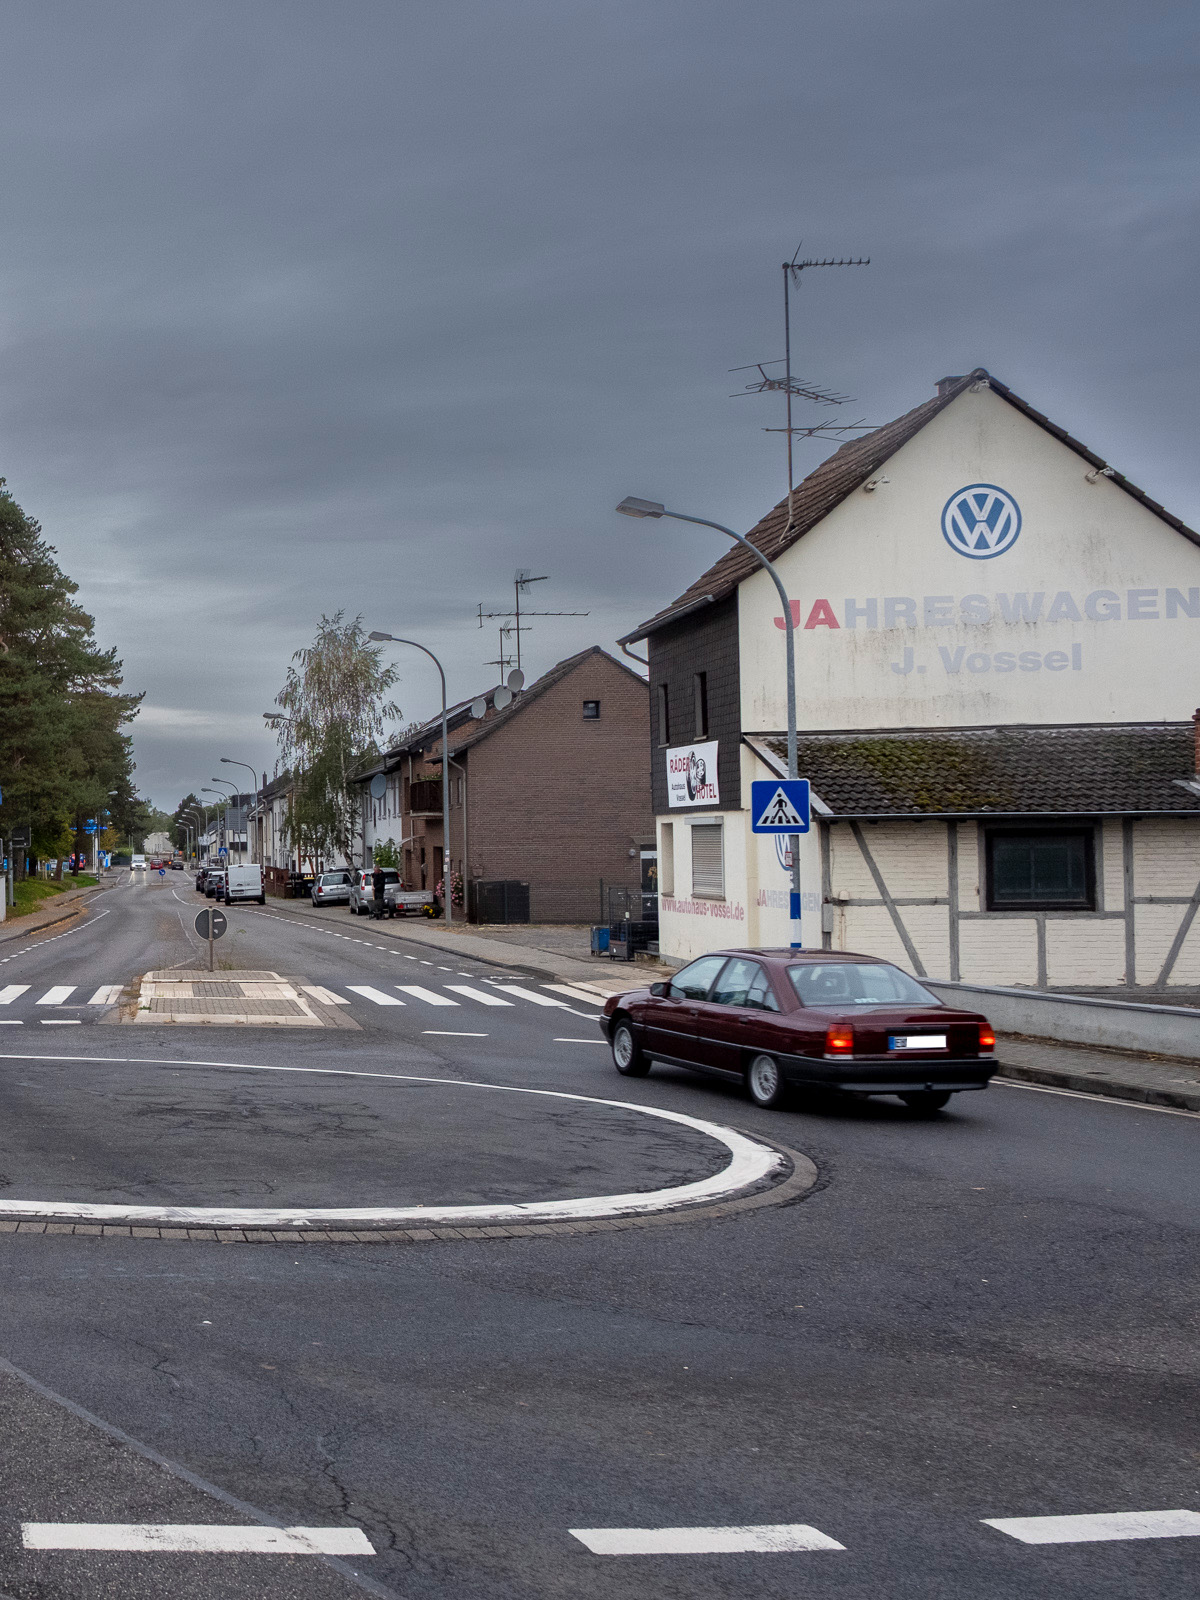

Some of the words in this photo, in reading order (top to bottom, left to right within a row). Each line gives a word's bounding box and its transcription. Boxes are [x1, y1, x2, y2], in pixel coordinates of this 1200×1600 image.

[773, 587, 1200, 630] JAHRESWAGEN
[891, 647, 926, 675] J.
[937, 643, 1082, 674] Vossel
[670, 755, 691, 774] RÄDER
[696, 783, 717, 799] HOTEL
[661, 897, 745, 921] www.autohaus-vossel.de
[756, 888, 821, 912] JAHRESGEN
